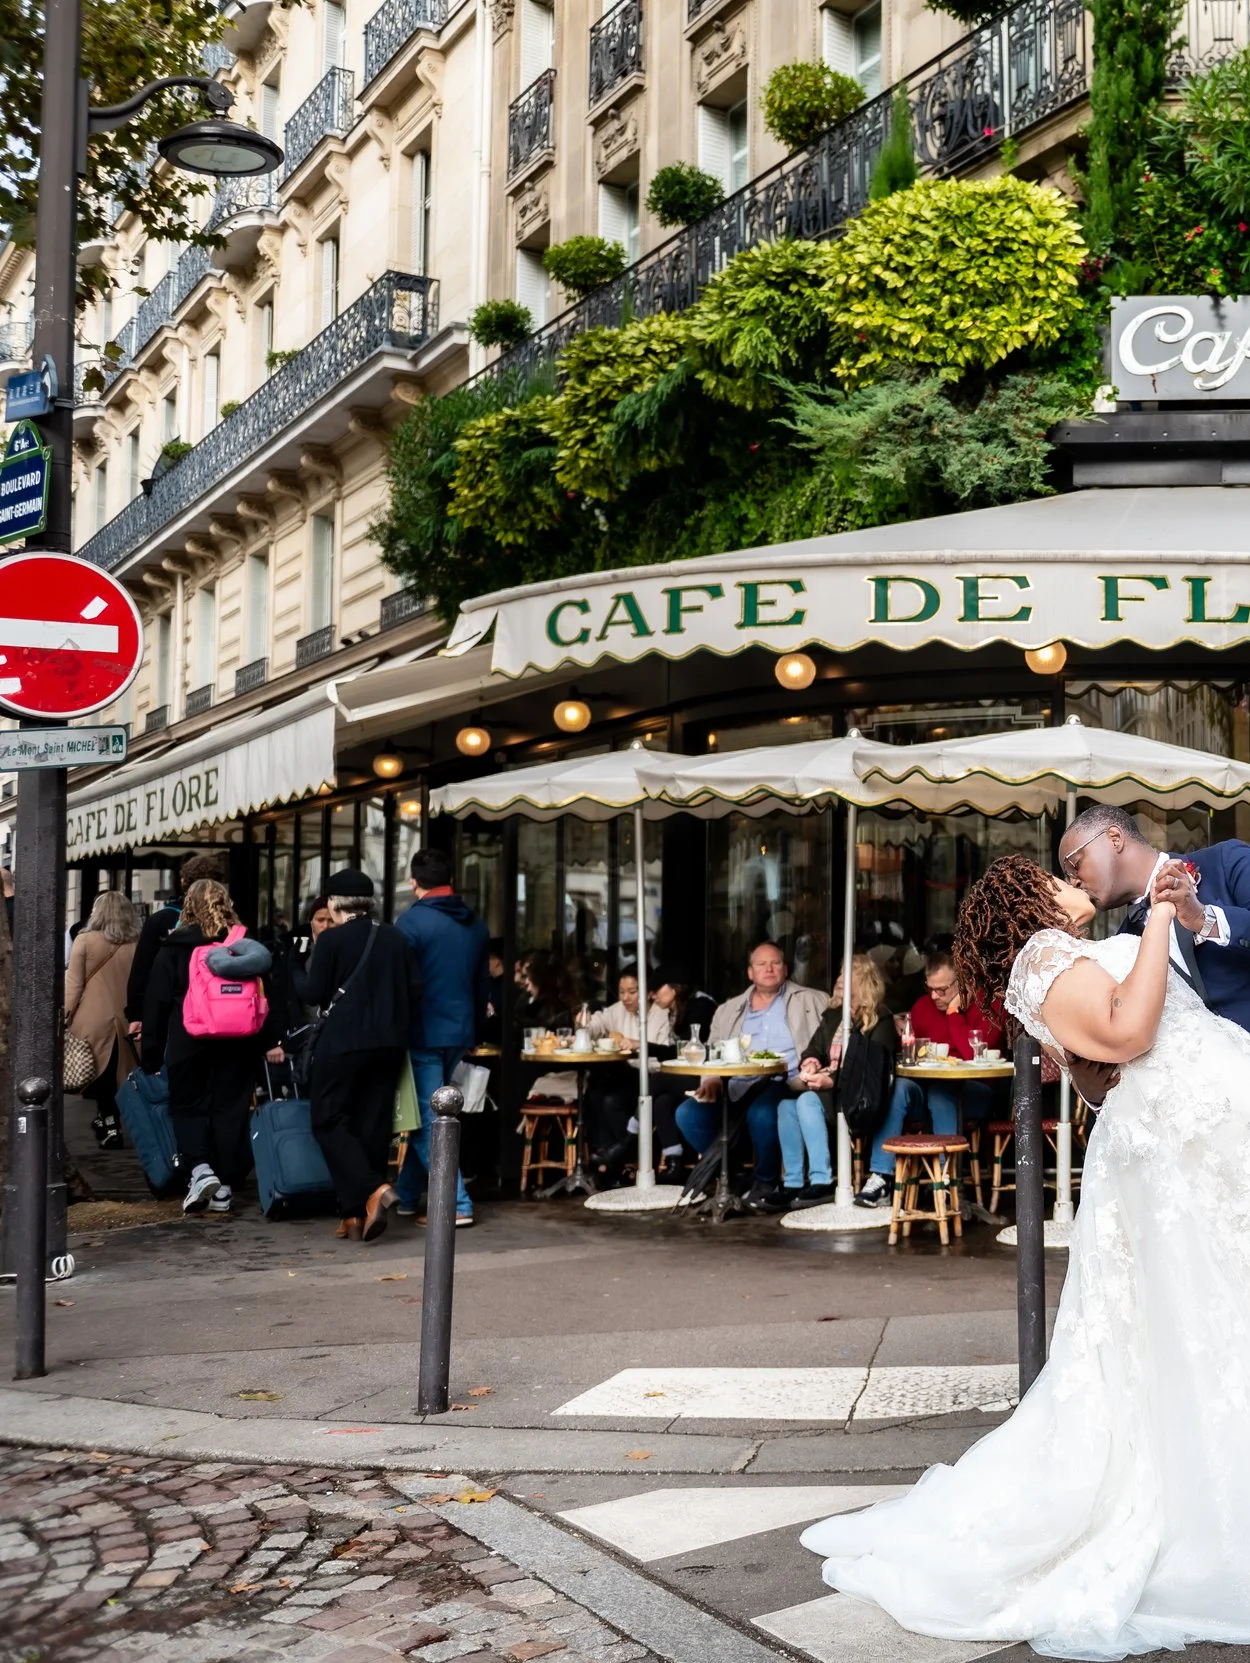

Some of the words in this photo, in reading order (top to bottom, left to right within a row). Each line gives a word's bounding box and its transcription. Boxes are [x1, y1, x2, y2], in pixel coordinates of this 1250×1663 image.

[0, 471, 41, 497] BOULEVARD
[545, 576, 808, 648] CAFE
[863, 573, 1034, 626] DE
[44, 743, 65, 754] Saint
[67, 740, 96, 753] MICHEL
[67, 807, 108, 848] CAFE
[113, 798, 138, 836] DE
[145, 767, 219, 827] FLORE
